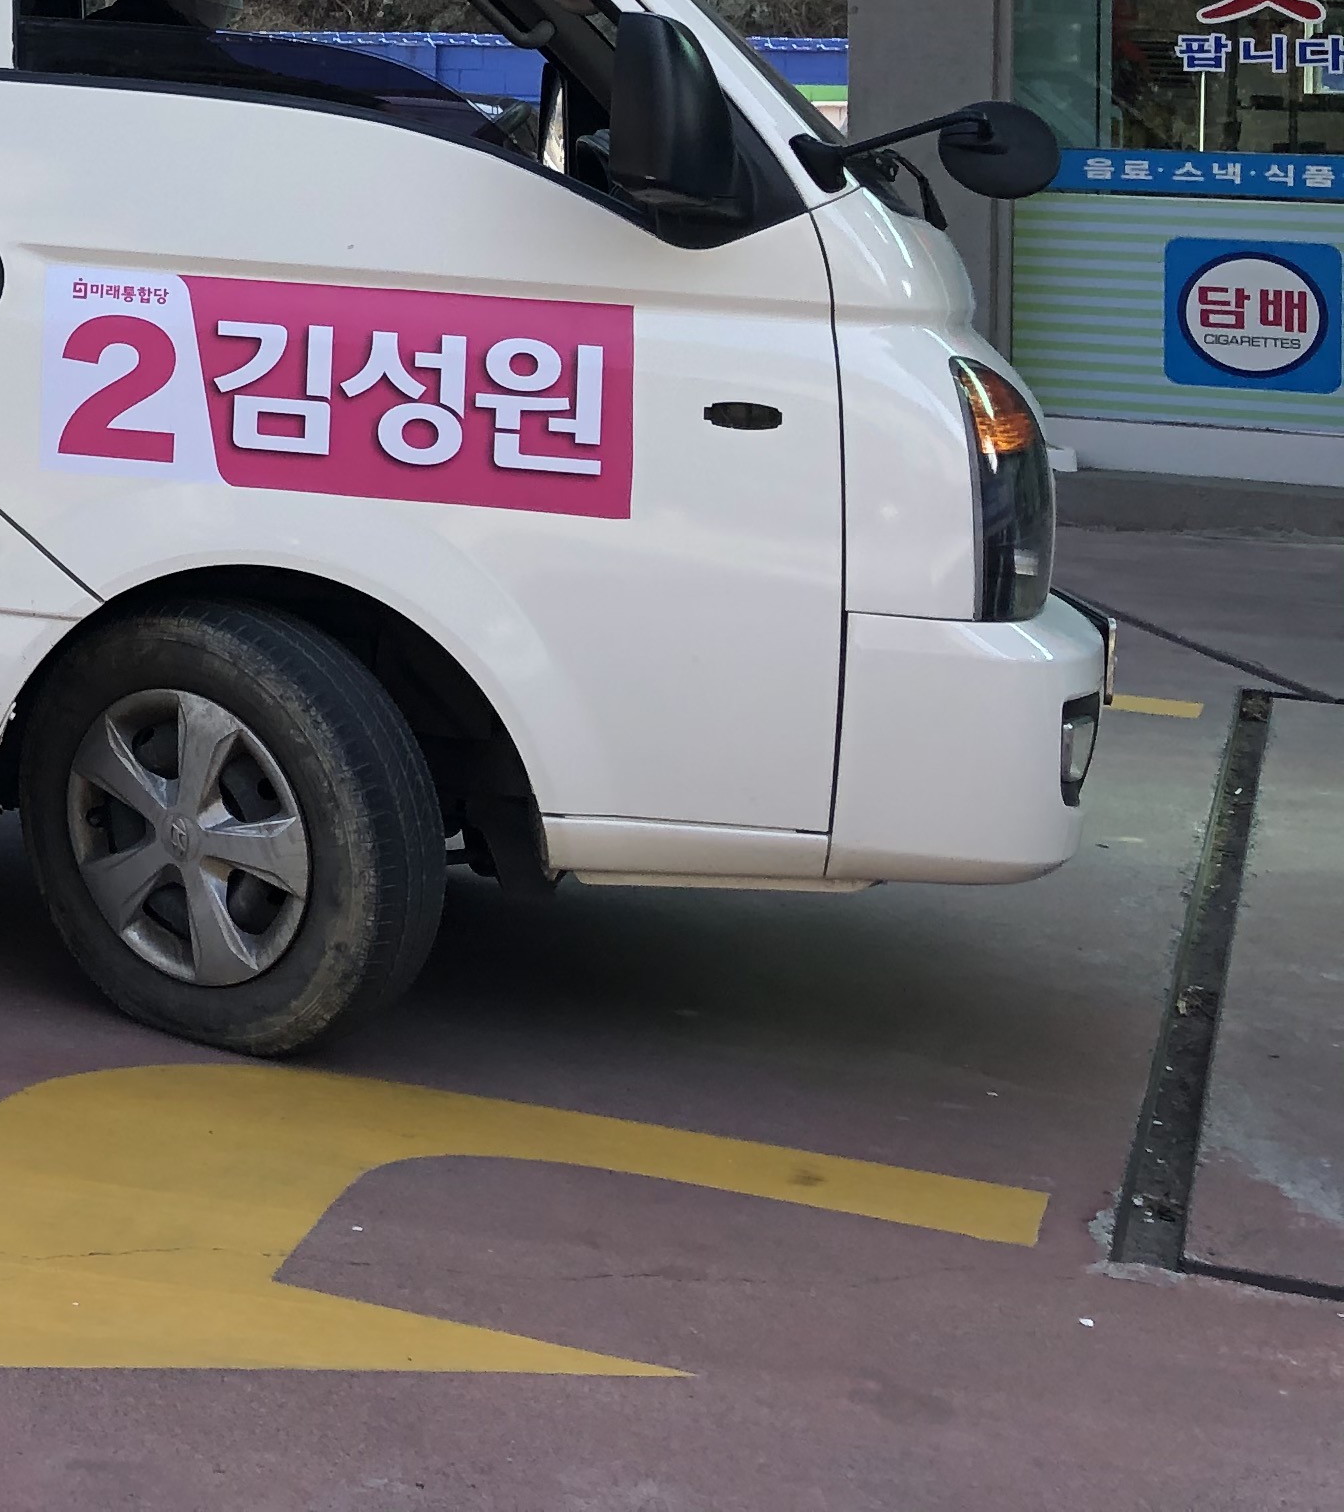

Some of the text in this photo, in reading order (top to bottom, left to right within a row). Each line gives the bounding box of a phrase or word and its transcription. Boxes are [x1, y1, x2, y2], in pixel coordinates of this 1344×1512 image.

[1177, 33, 1344, 74] 팝니다
[89, 281, 170, 306] 미래통합당
[1197, 285, 1308, 334] 담배
[1202, 332, 1302, 351] CIGARETTES
[57, 313, 606, 477] 2 김성원
